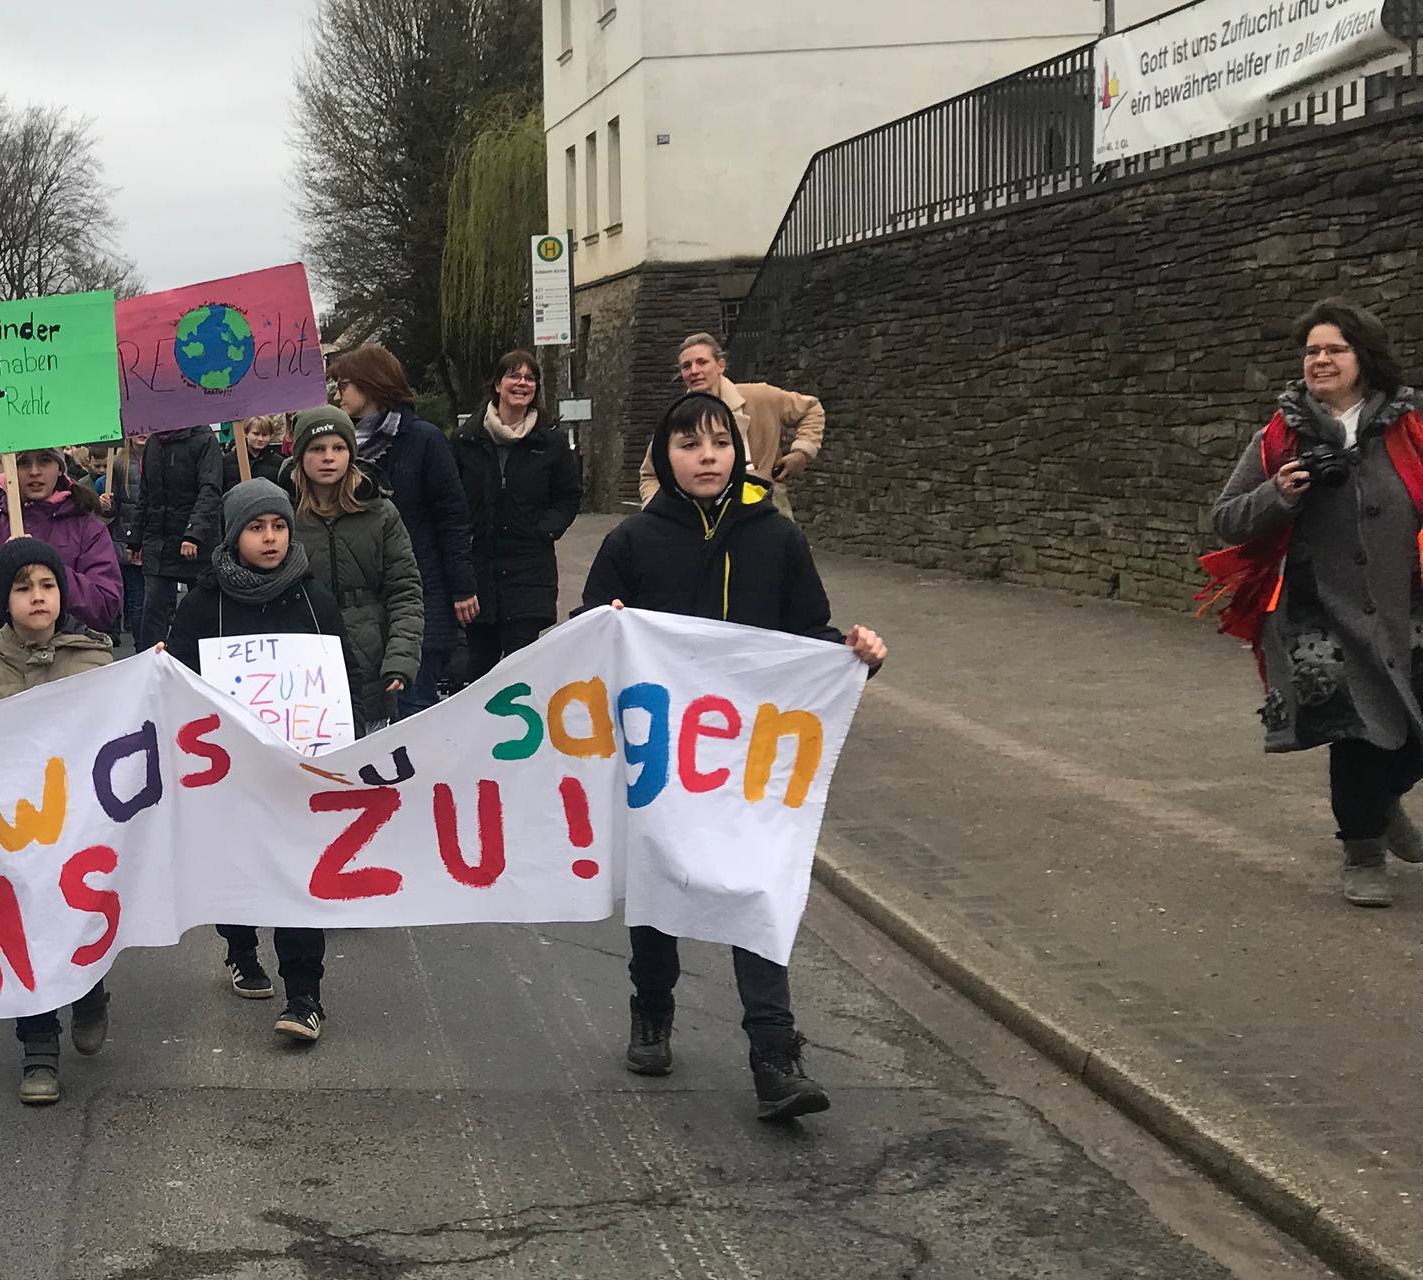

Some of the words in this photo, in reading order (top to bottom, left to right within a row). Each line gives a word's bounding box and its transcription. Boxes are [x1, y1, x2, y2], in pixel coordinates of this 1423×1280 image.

[1130, 92, 1151, 116] ein
[1226, 51, 1271, 86] Helfer
[1275, 43, 1290, 70] in
[1293, 30, 1328, 62] allen
[1329, 8, 1376, 46] Nöten
[1140, 47, 1168, 76] Gott
[1173, 39, 1189, 66] ist
[1192, 33, 1217, 66] uns
[1221, 4, 1284, 48] Zuflucht
[227, 638, 279, 662] ZEIT
[246, 665, 326, 705] ZUM
[259, 704, 350, 742] PIEL-
[484, 675, 824, 809] sagen
